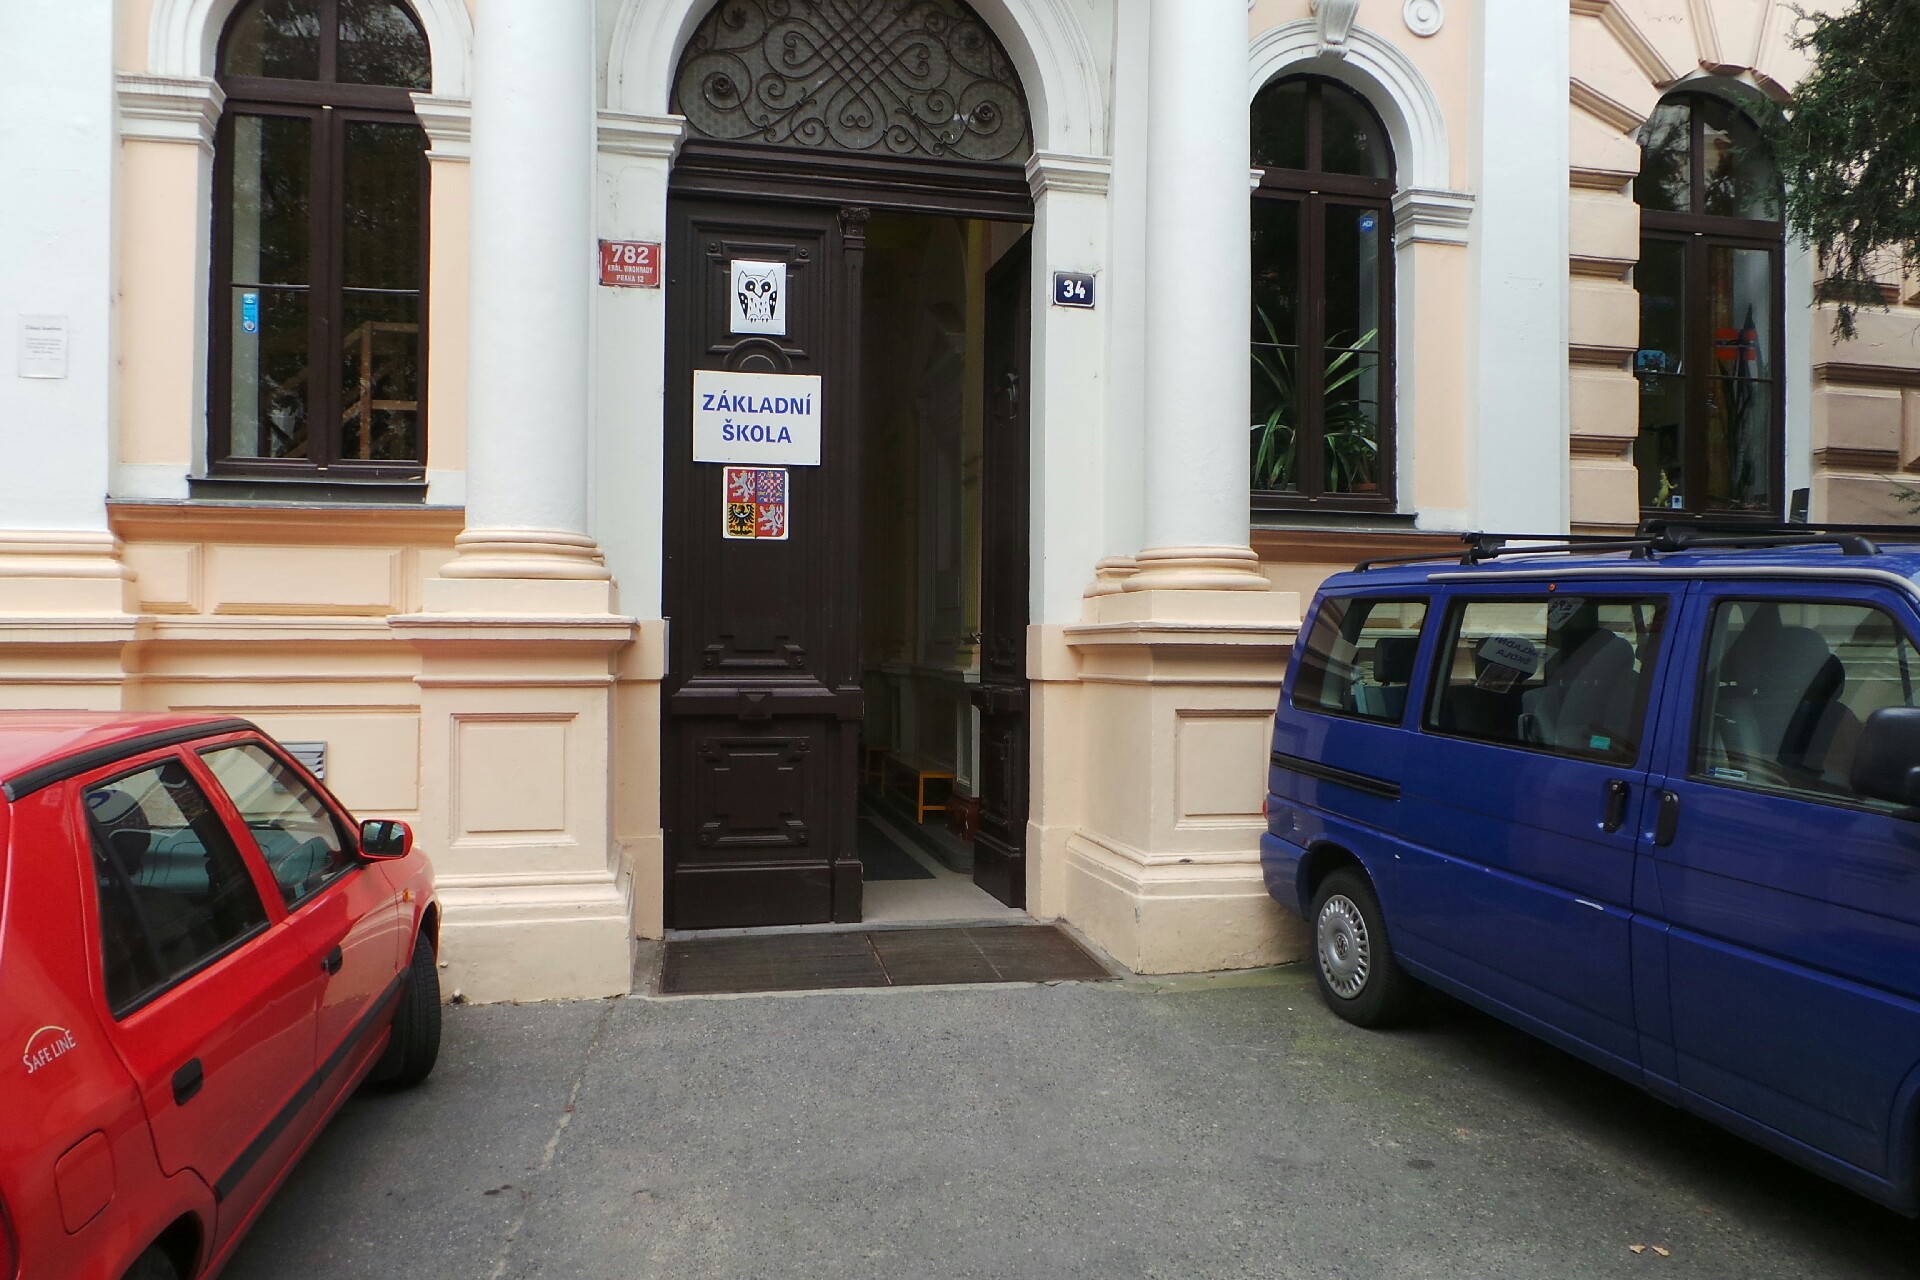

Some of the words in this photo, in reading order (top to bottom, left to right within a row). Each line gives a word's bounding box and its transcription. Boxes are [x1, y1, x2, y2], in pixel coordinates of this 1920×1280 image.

[611, 244, 650, 264] 782
[616, 274, 636, 282] PRAHA
[637, 275, 645, 283] 12
[623, 265, 653, 274] VINOHRADY
[1063, 279, 1086, 299] 34
[702, 389, 812, 415] ZÁKLADNÍ
[722, 418, 792, 443] ŠKOLA
[23, 1047, 53, 1073] SAFE
[50, 1029, 76, 1057] LINE
